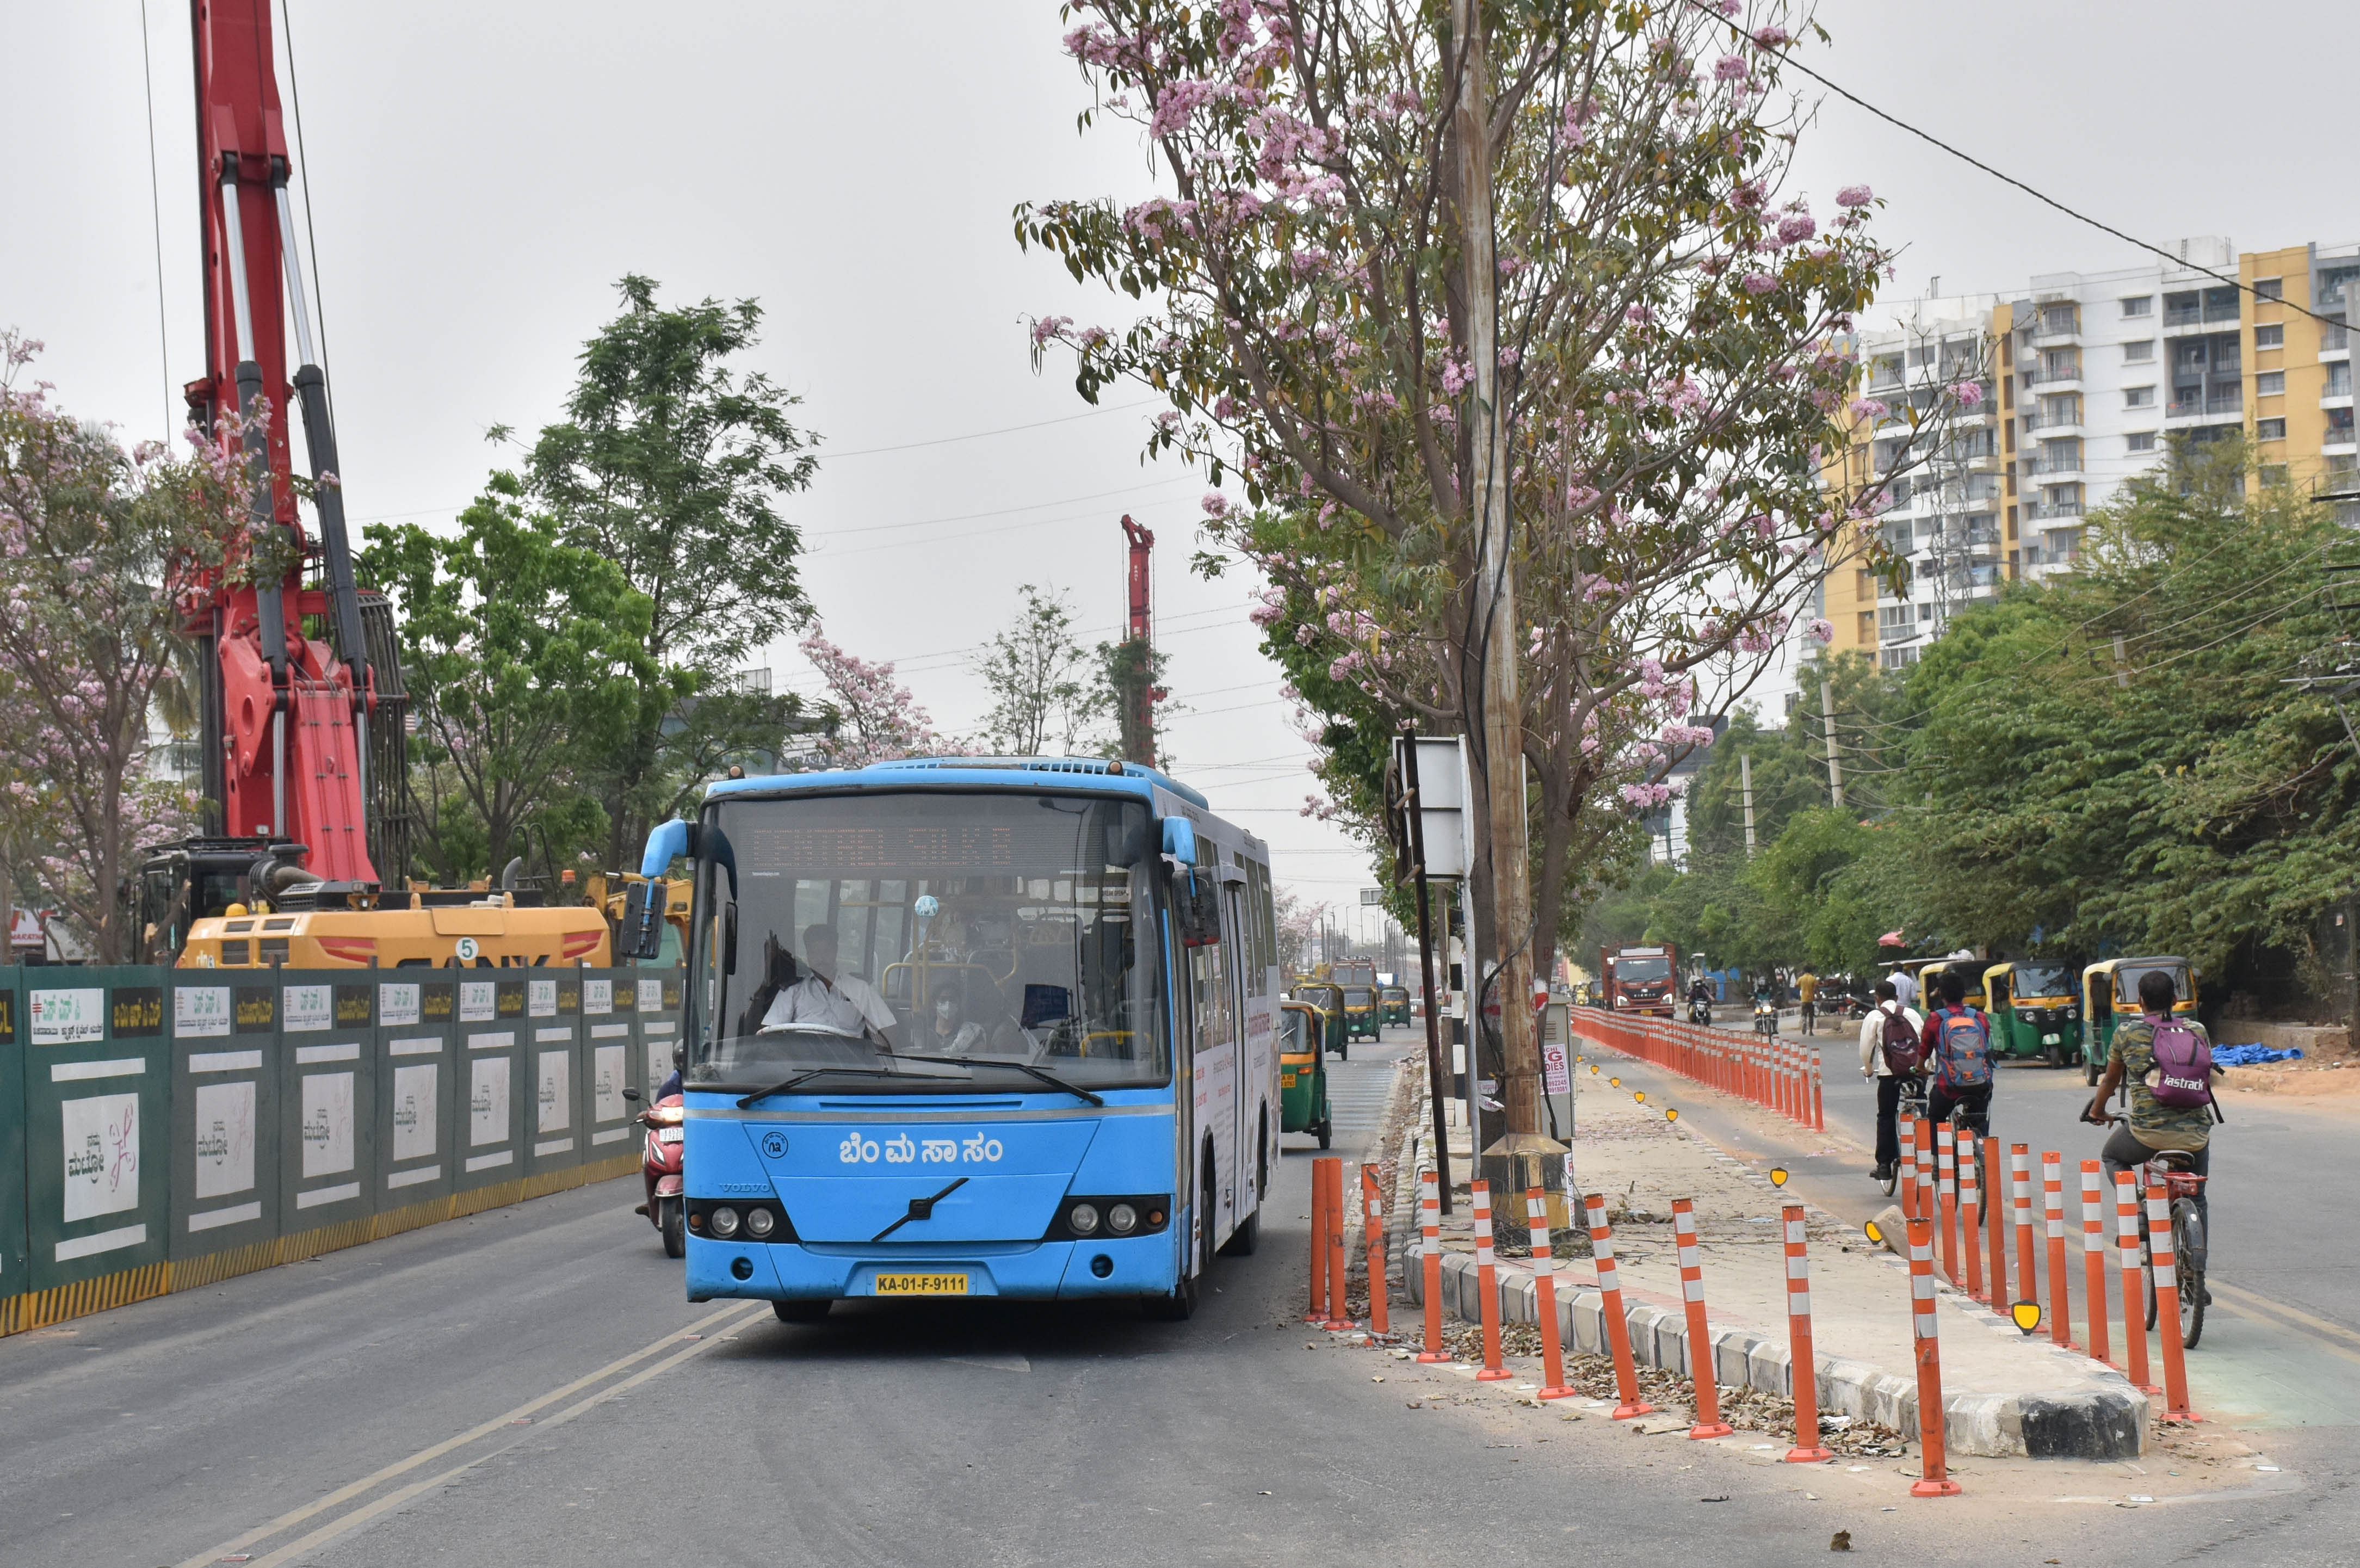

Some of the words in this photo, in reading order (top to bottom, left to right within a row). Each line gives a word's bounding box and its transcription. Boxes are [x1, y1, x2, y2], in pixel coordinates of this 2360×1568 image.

[909, 827, 980, 866] SILK
[461, 939, 473, 959] 5
[1545, 1062, 1564, 1071] DIES
[2164, 1074, 2205, 1091] fastrack
[839, 1132, 880, 1163] ಬೆಂ
[885, 1132, 916, 1163] ಮ
[922, 1139, 957, 1163] ಸಾ
[962, 1131, 1003, 1163] ಸಂ
[718, 1183, 771, 1193] VOLVO
[878, 1277, 965, 1291] KA-01-F-9111
